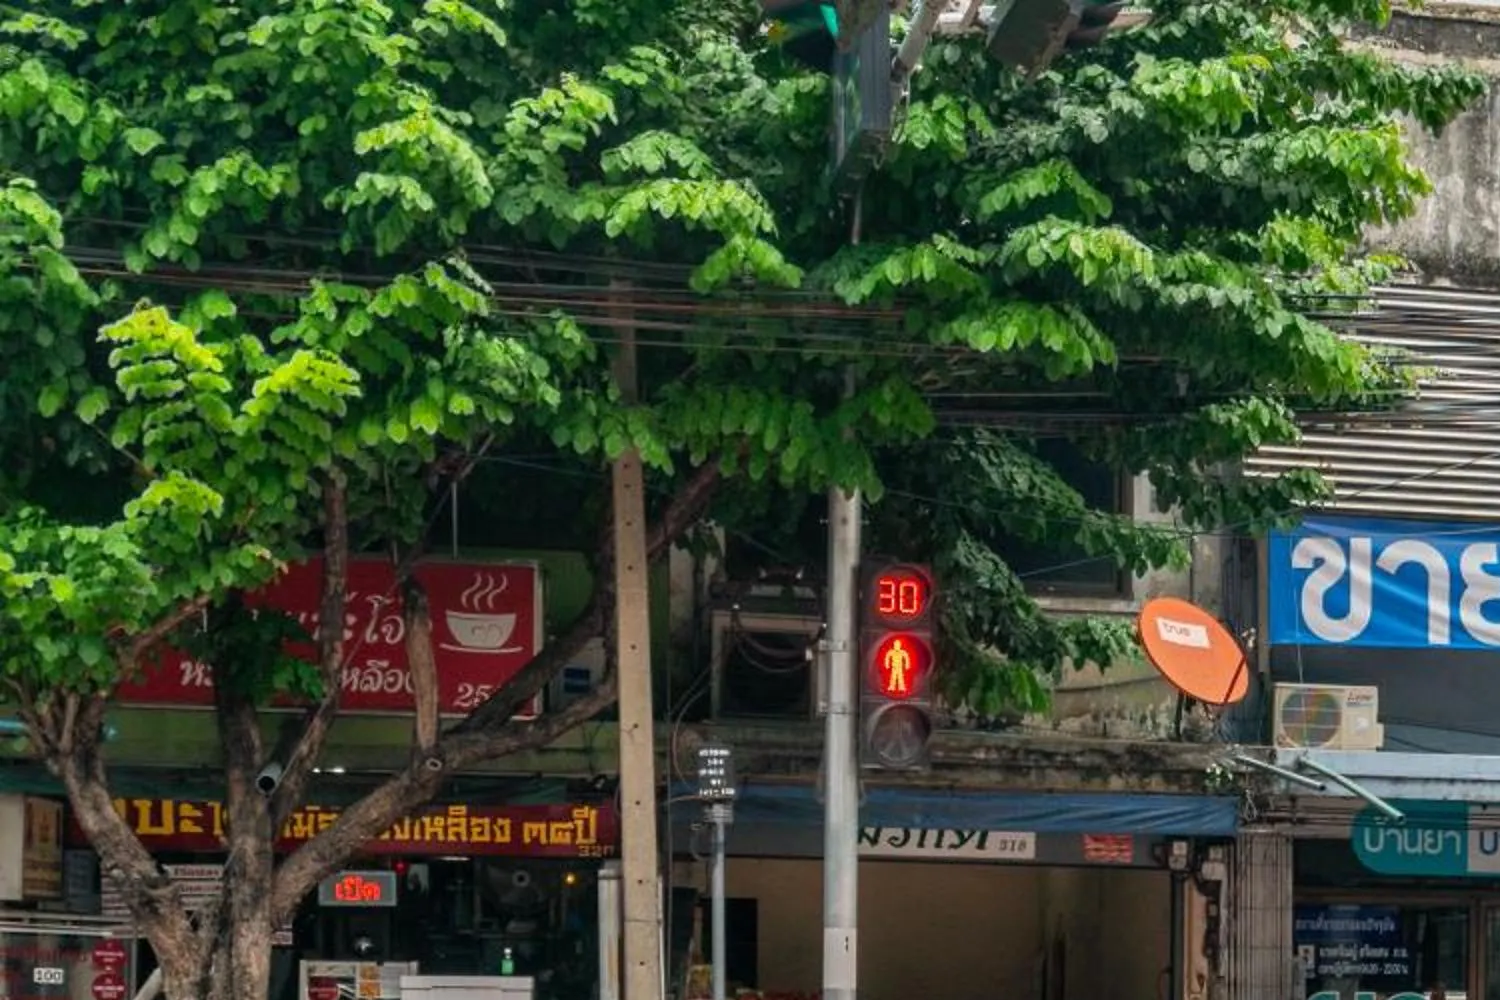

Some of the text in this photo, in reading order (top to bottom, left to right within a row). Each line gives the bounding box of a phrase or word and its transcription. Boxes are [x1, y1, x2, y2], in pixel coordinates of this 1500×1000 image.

[879, 579, 917, 614] 30
[1363, 815, 1462, 856] บ้านยา
